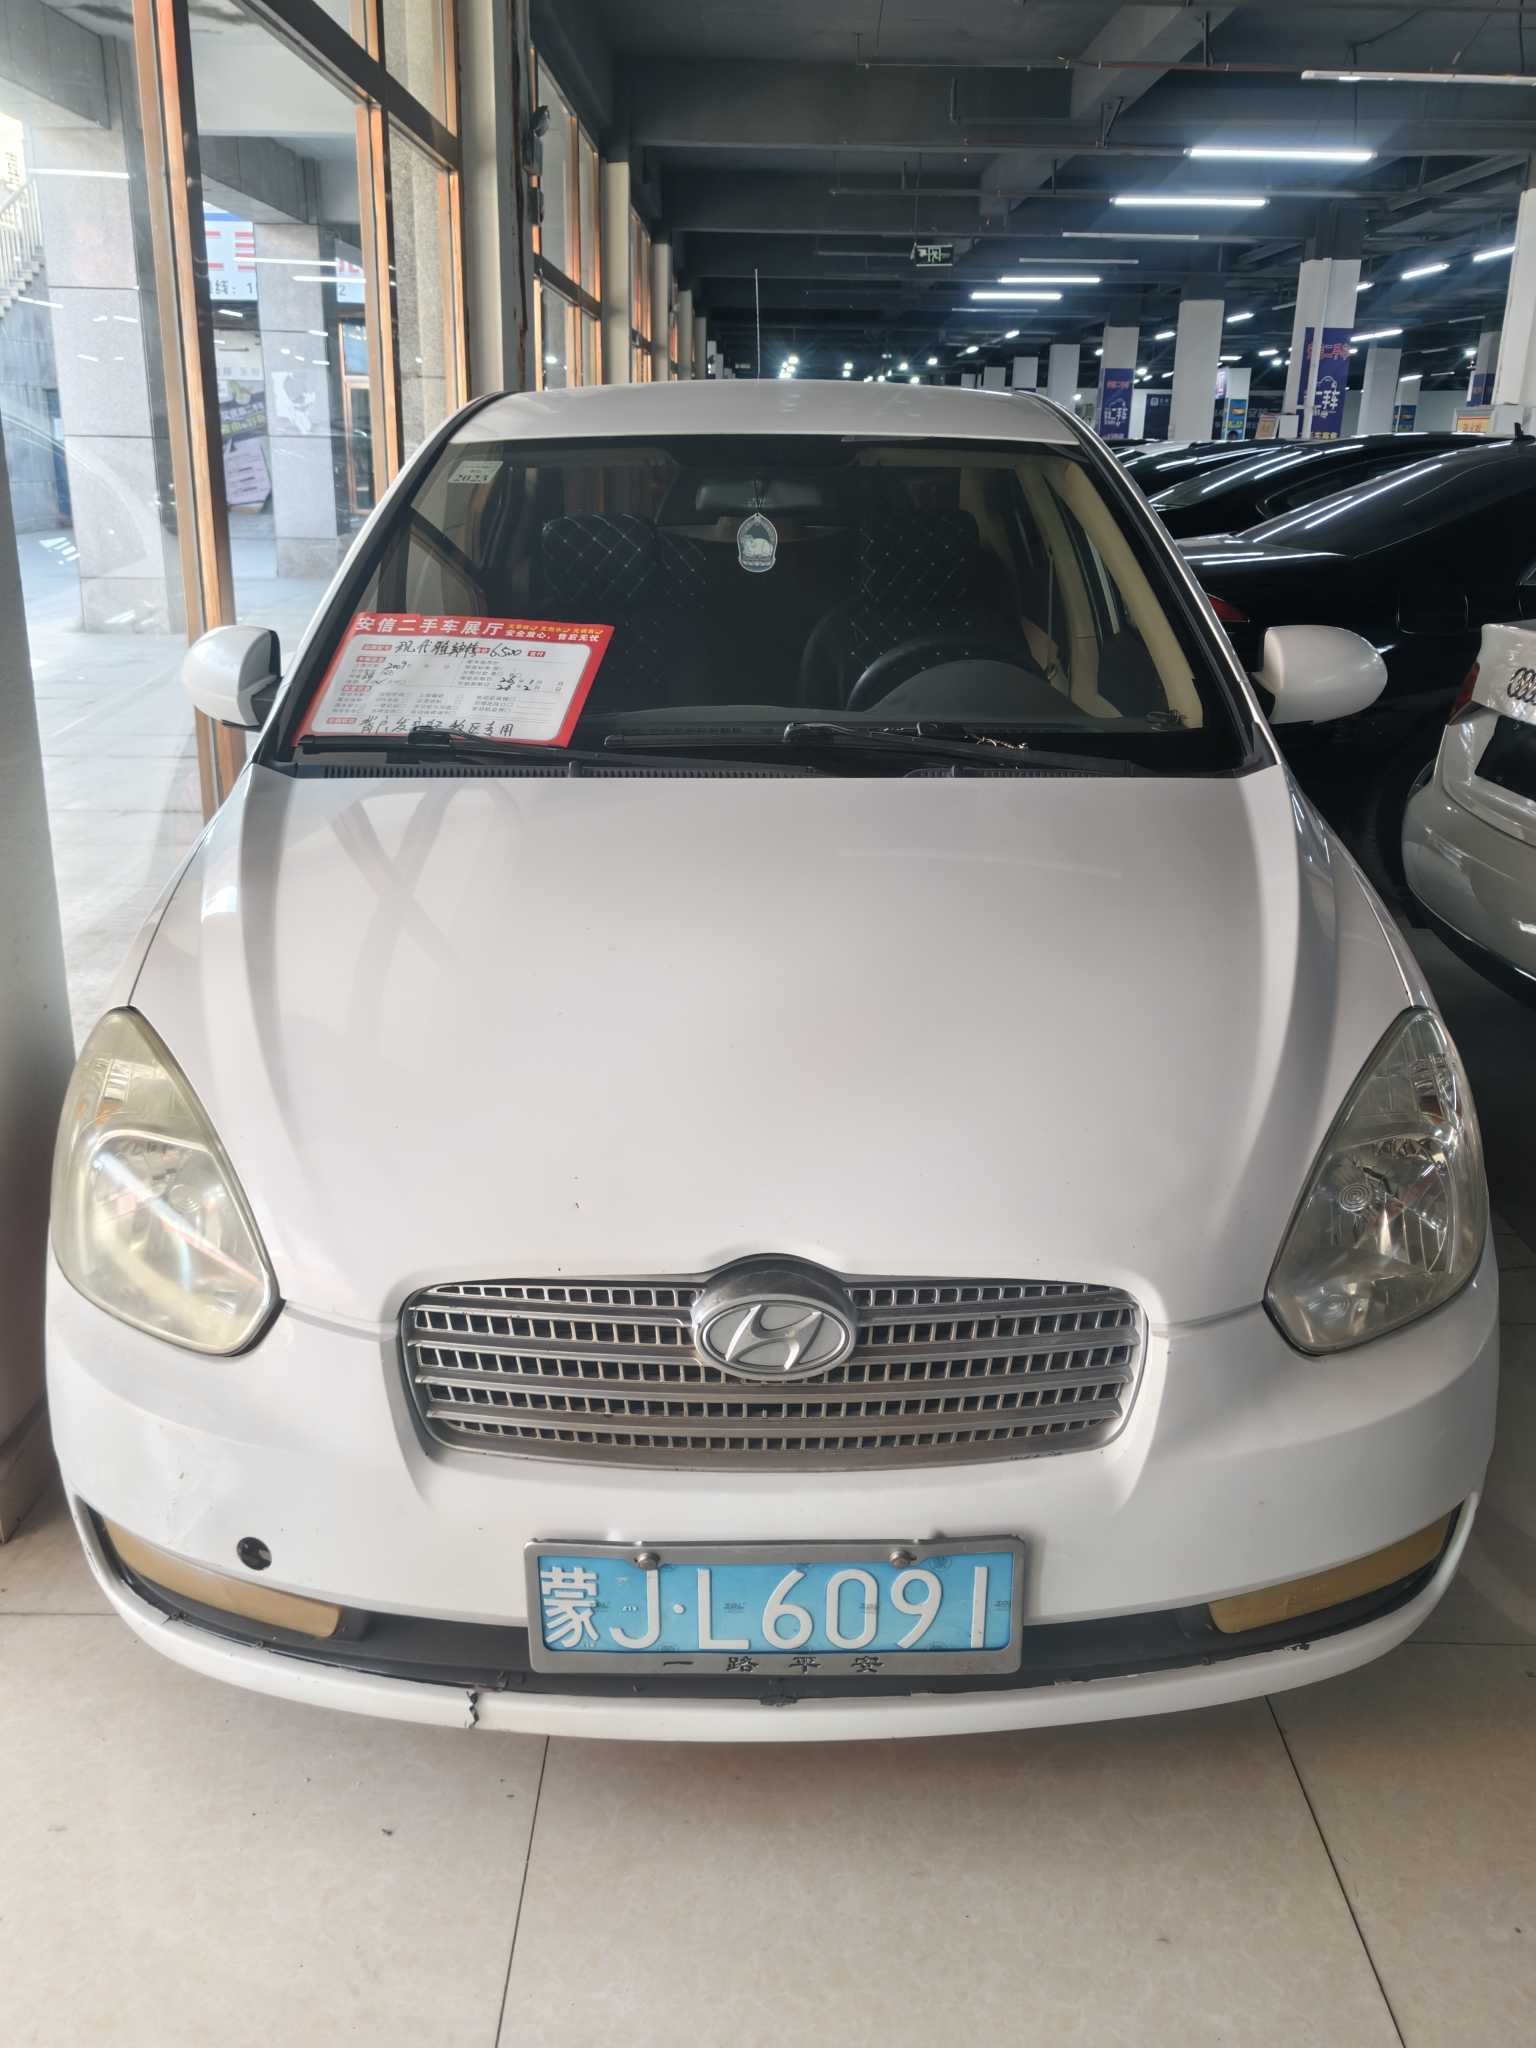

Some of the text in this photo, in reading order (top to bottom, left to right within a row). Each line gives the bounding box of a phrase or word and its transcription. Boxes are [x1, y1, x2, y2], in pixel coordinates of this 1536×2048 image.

[355, 616, 504, 637] 安信二手车展厅
[539, 1565, 989, 1650] 蒙J·L6091
[662, 1654, 886, 1674] 一路平安
